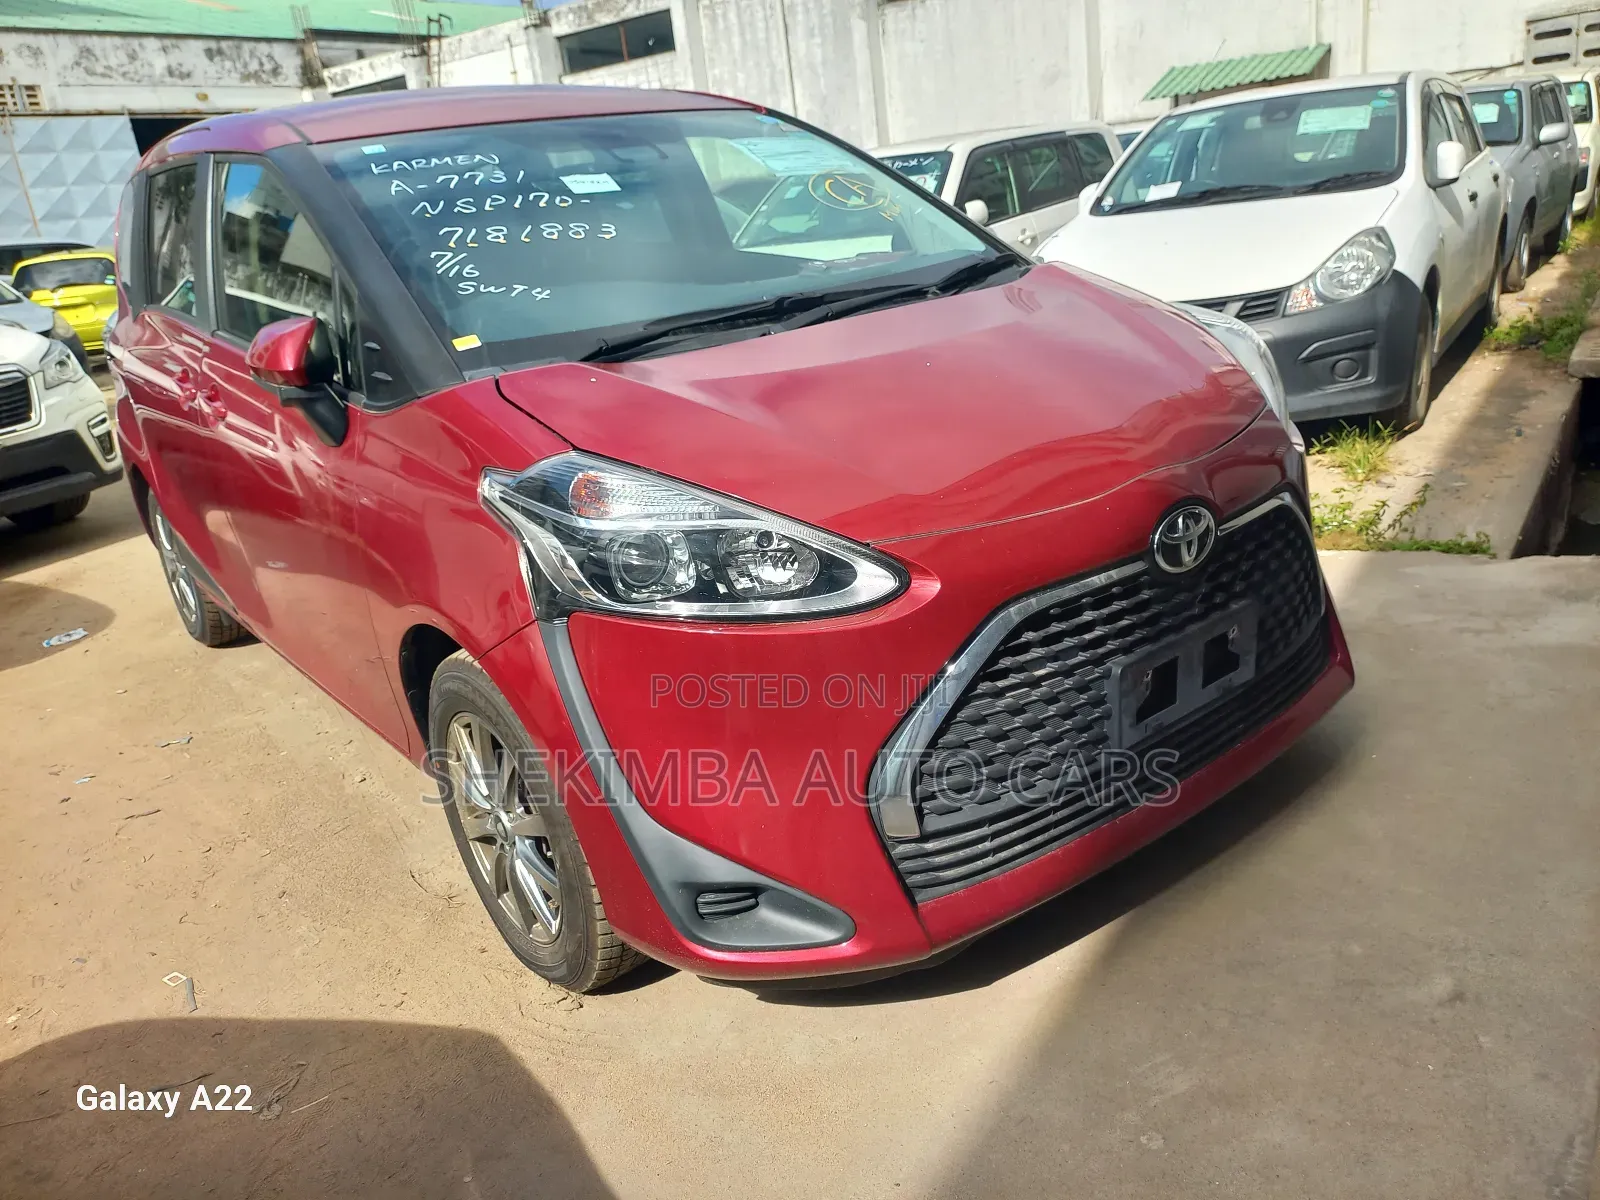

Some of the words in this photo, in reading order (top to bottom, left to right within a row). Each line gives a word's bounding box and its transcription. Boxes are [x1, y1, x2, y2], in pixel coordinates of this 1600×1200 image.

[370, 153, 500, 176] KARMEN
[390, 169, 525, 196] A-7731
[410, 191, 591, 217] NSP170-
[438, 222, 617, 248] 7181883
[429, 251, 480, 278] 7/16
